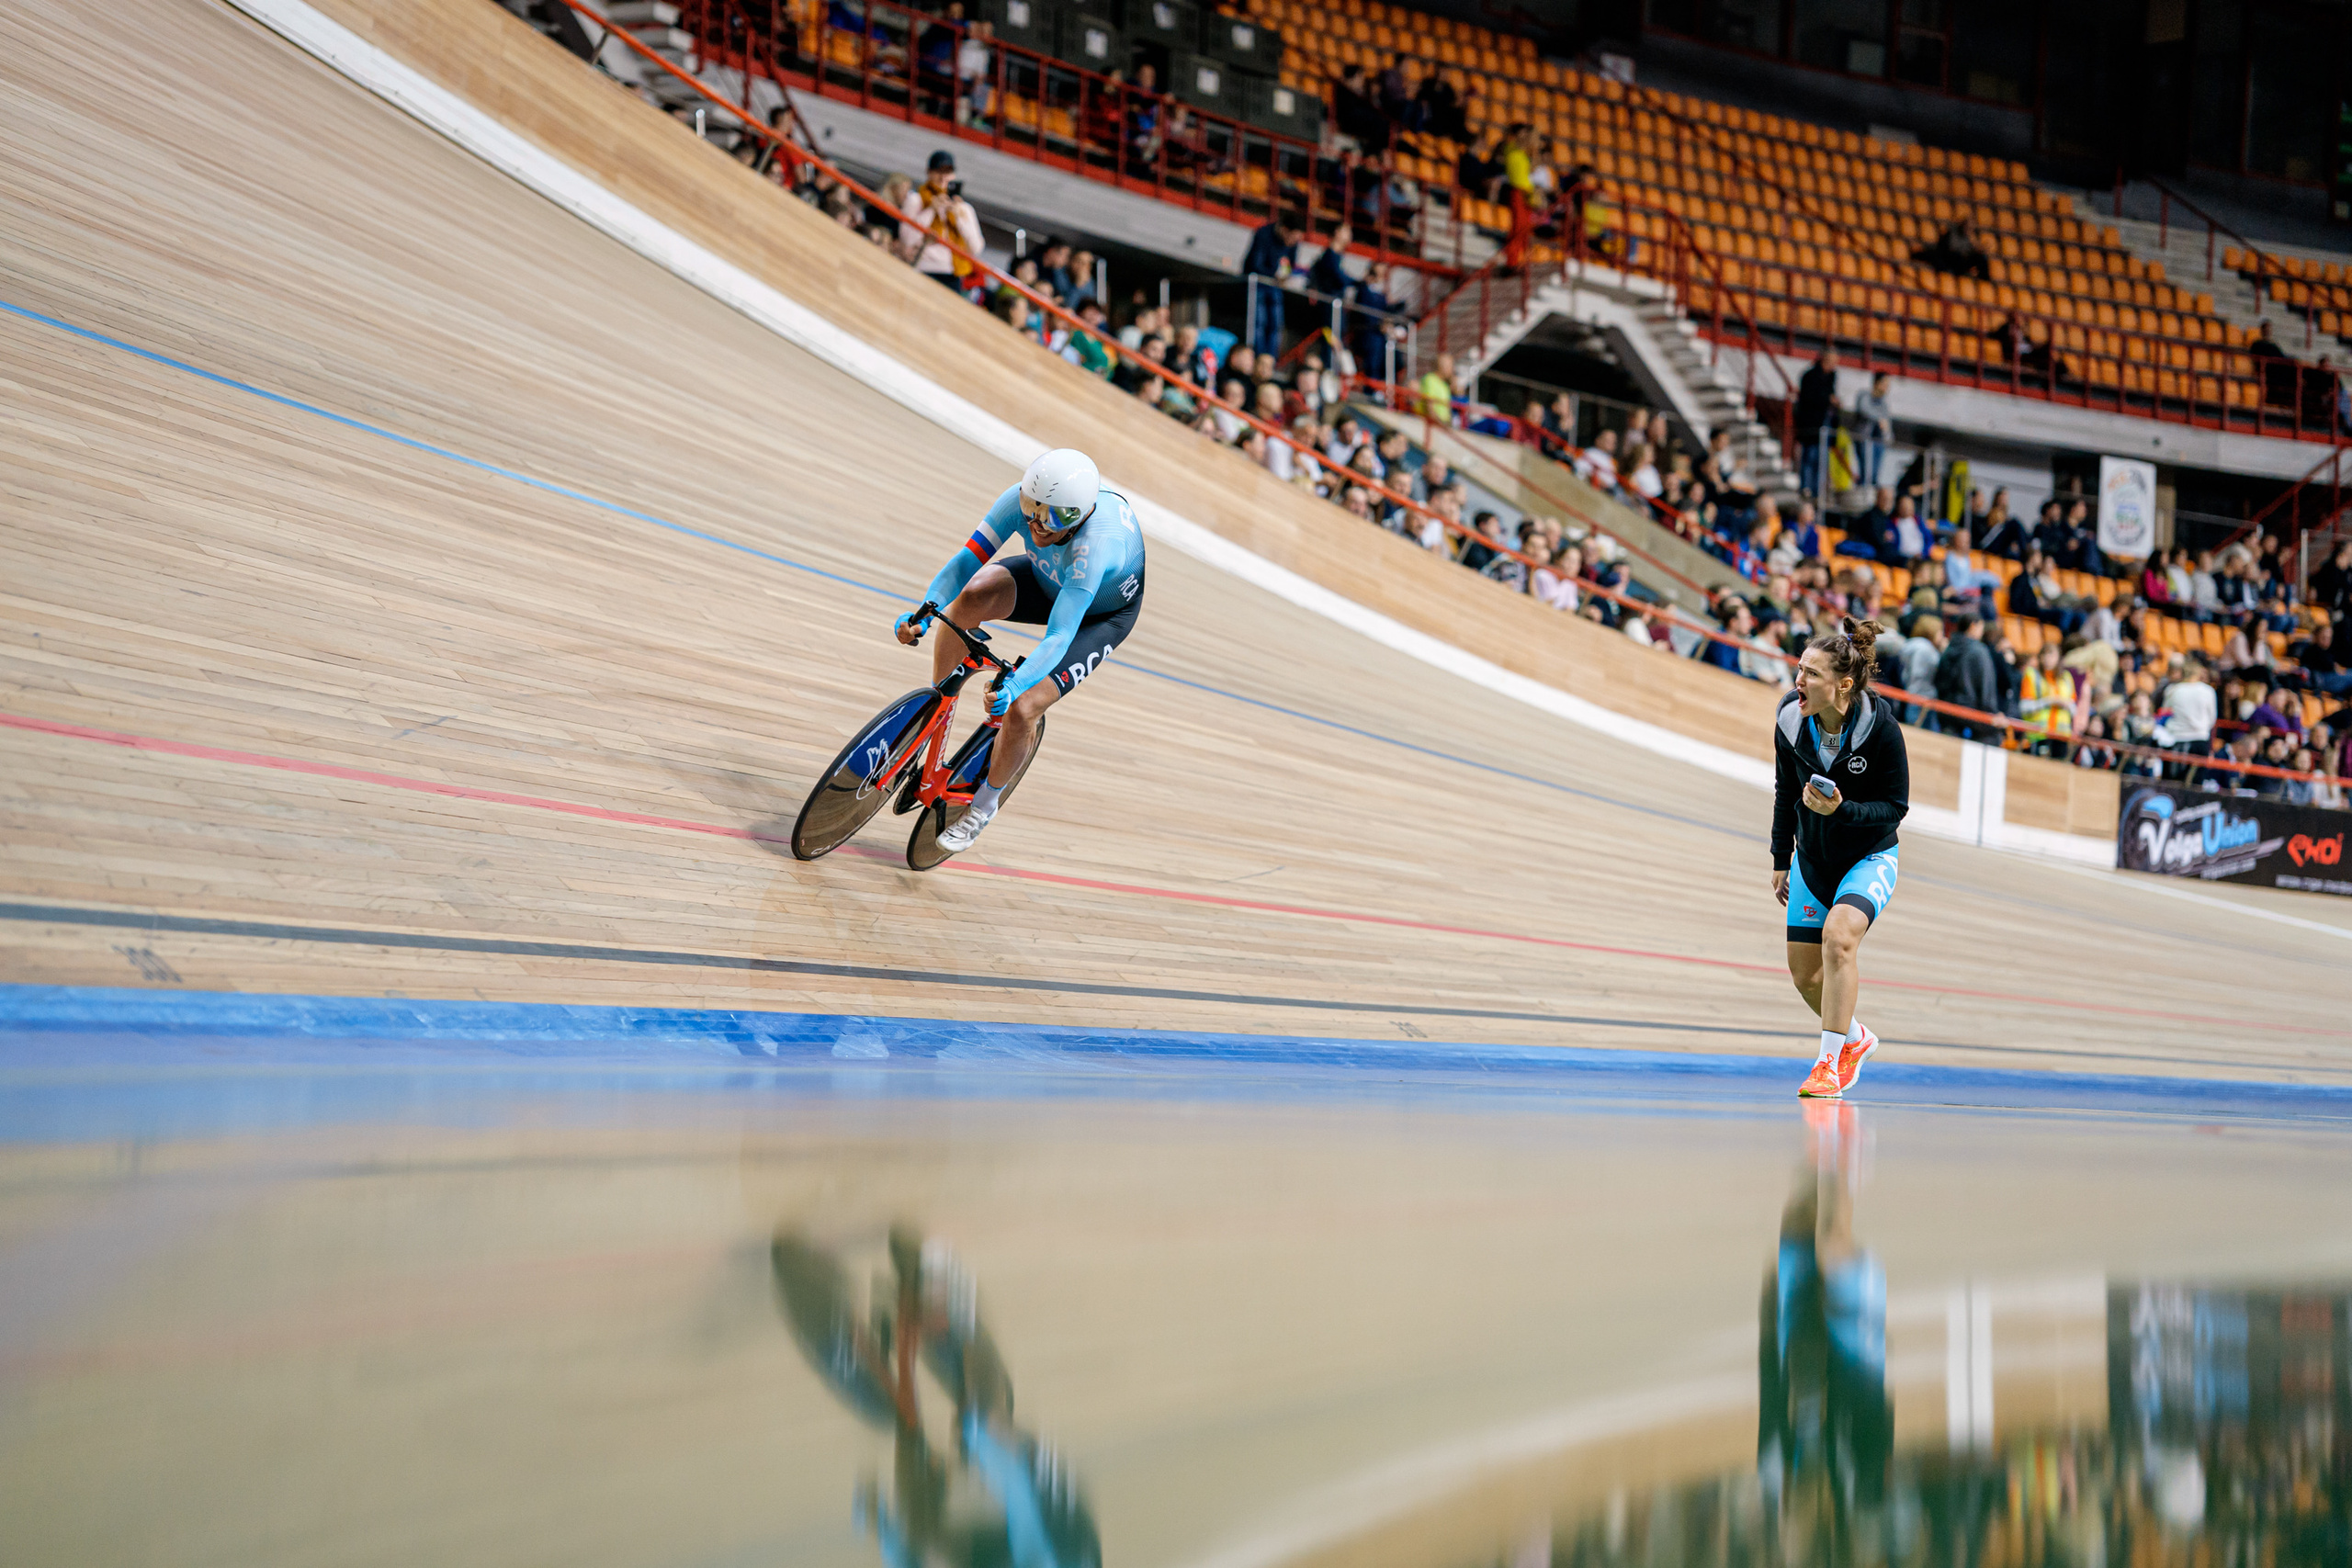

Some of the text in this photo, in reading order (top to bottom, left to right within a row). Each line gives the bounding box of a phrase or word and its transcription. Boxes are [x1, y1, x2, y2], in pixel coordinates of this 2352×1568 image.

[1026, 548, 1064, 588] RCA
[1071, 545, 1090, 580] RCA
[1118, 573, 1139, 602] RCA
[1851, 761, 1863, 769] RCA
[1867, 853, 1898, 914] RCA
